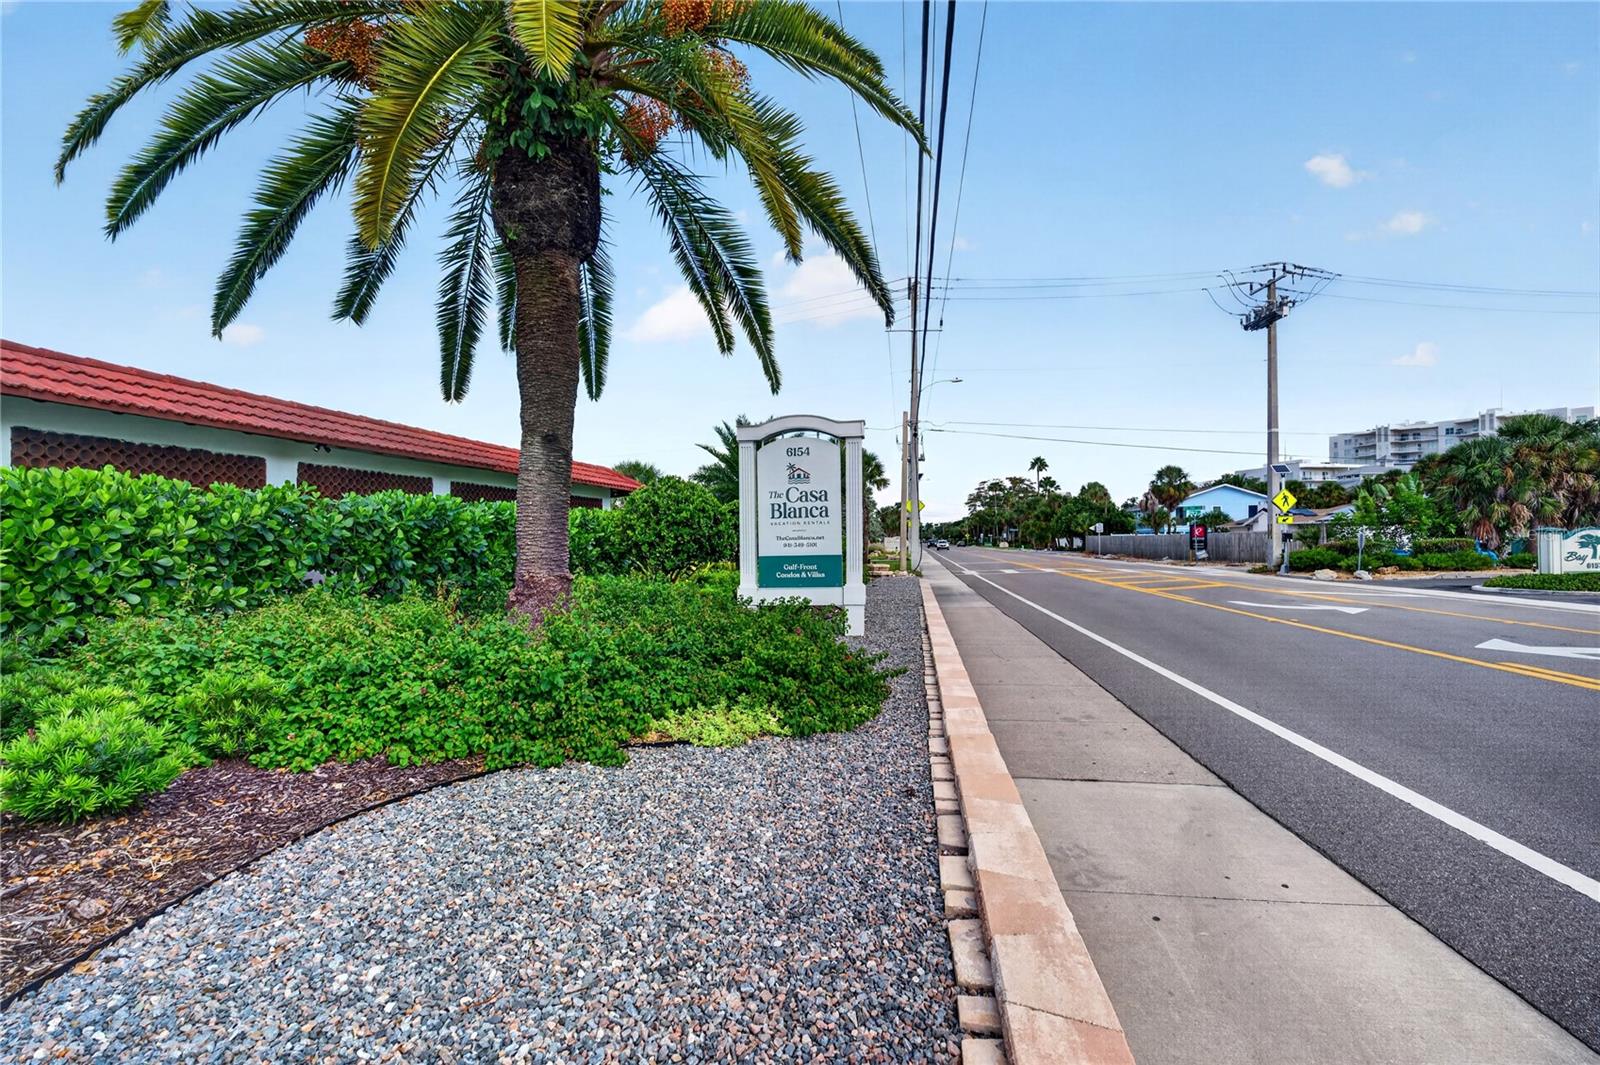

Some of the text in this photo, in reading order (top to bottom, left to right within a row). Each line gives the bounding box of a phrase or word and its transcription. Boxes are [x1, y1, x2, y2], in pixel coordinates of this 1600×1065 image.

[786, 447, 810, 457] 6154
[769, 487, 828, 503] The Casa
[770, 502, 829, 519] Blanca
[1564, 551, 1588, 565] Bay
